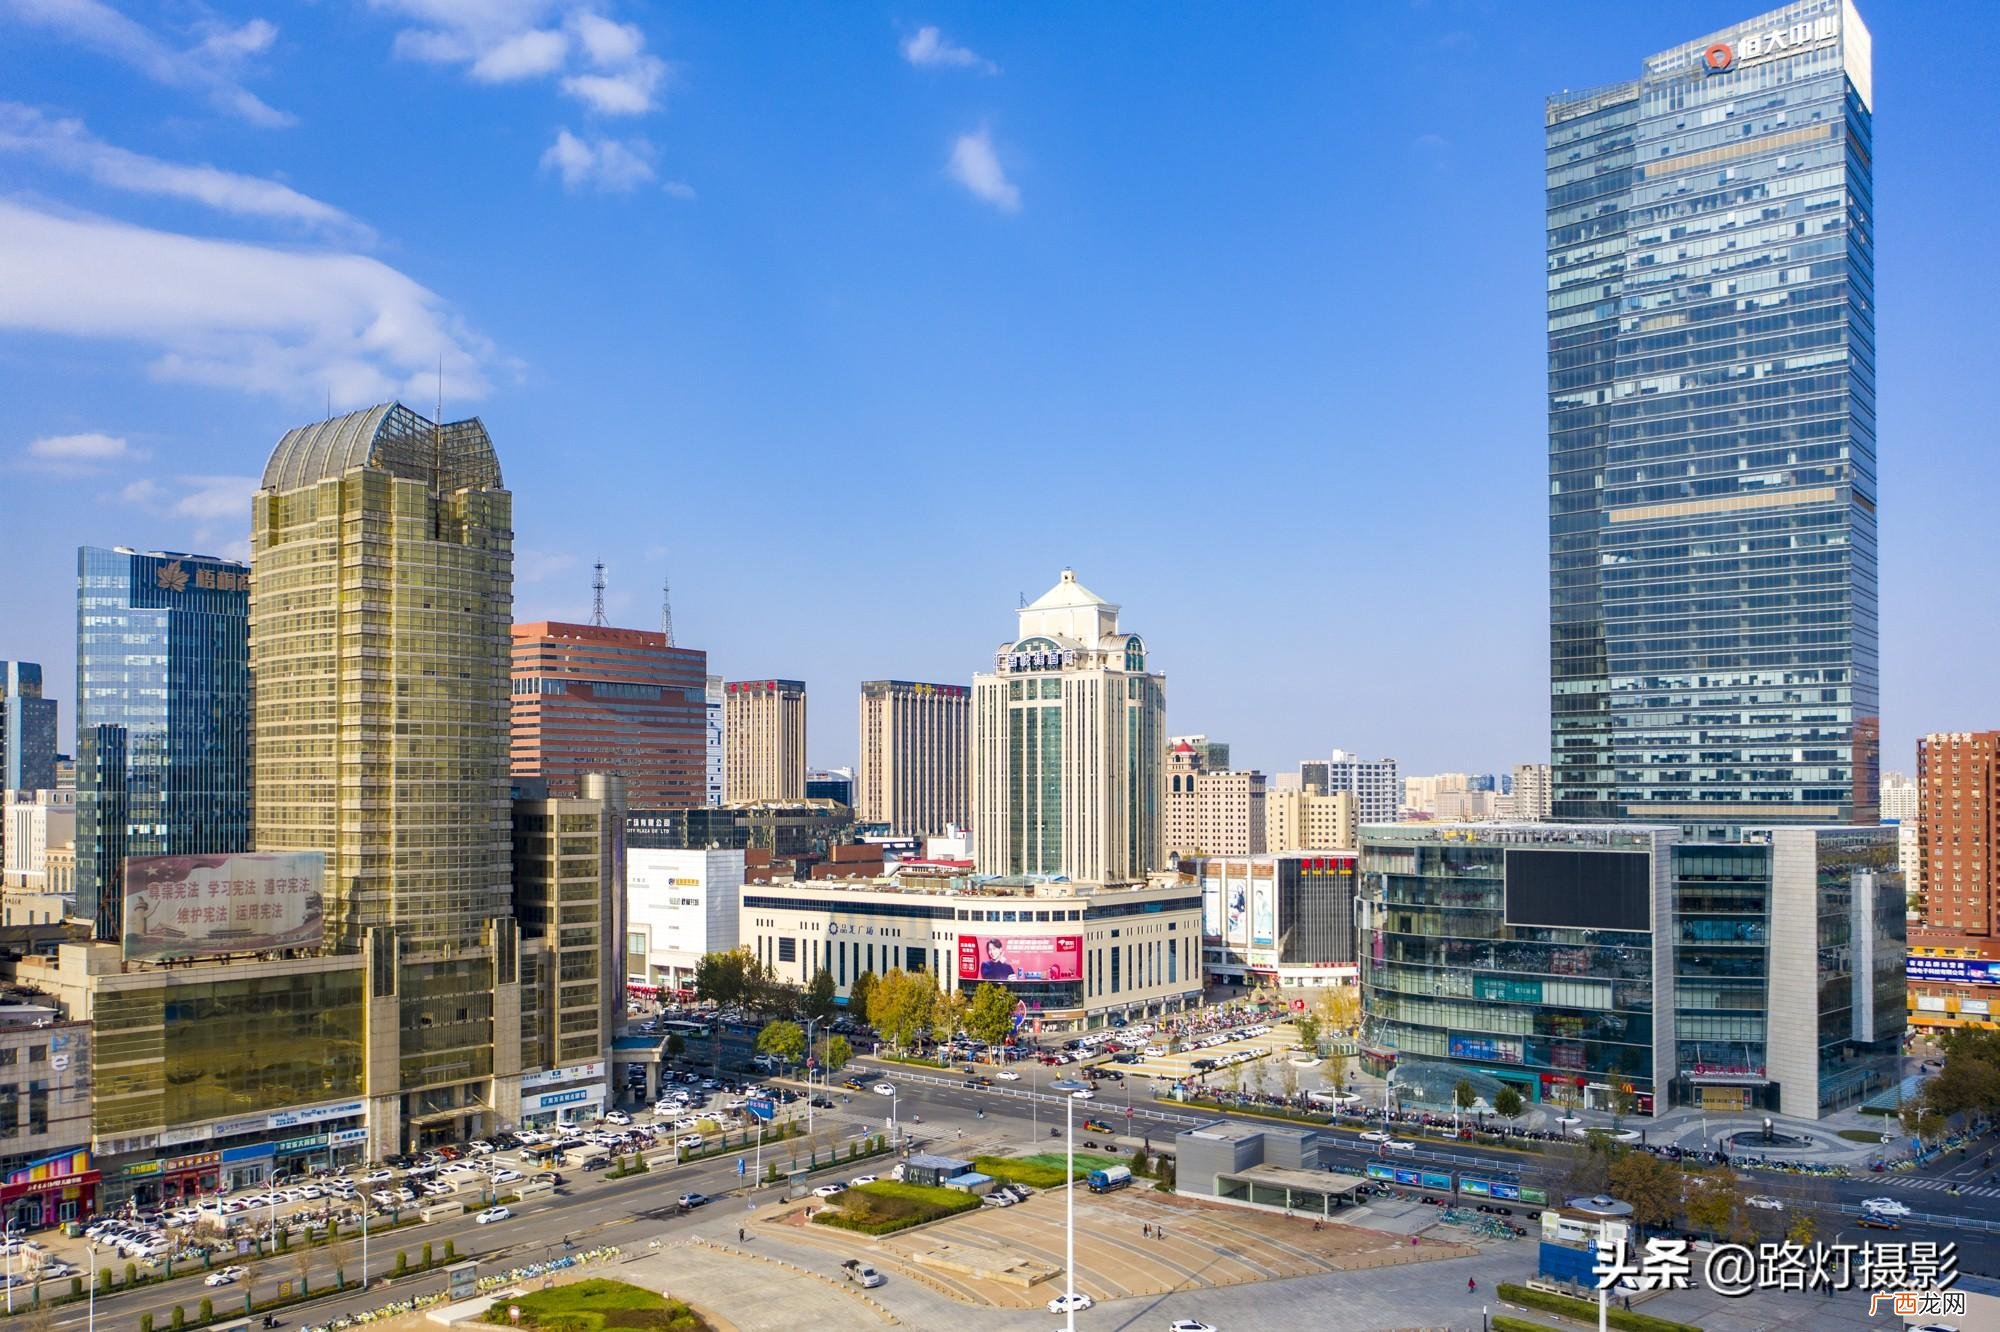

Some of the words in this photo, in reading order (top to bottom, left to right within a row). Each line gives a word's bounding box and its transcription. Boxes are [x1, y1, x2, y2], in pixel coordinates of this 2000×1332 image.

[1738, 15, 1838, 60] 恒大中心
[148, 881, 199, 900] 尊崇宪法
[208, 879, 257, 897] 学习宪法
[264, 877, 311, 895] 遵守宪法
[177, 905, 228, 924] 维护宪法
[235, 902, 284, 921] 运用宪法
